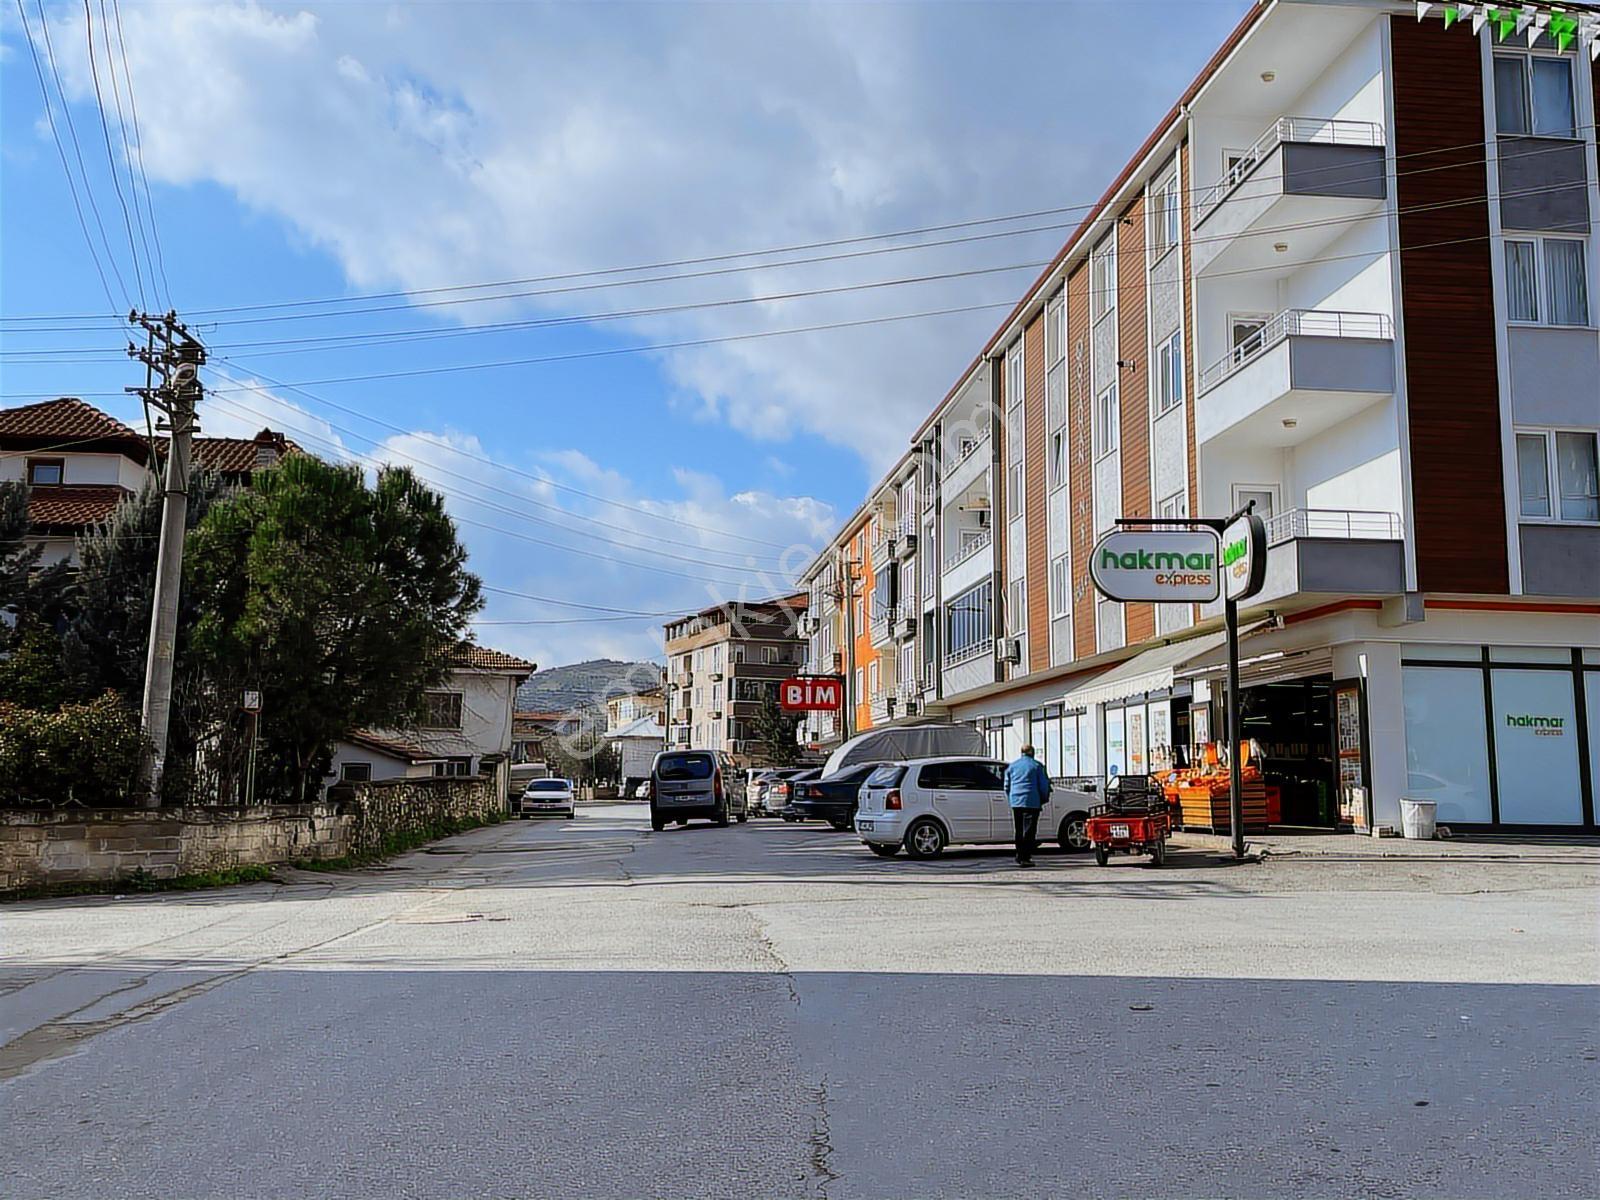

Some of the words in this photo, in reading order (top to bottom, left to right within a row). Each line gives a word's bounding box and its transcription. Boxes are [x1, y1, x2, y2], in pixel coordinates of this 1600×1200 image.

[1101, 548, 1215, 570] hakmar
[1155, 571, 1212, 587] express
[787, 680, 836, 705] BİM
[1506, 714, 1564, 727] hakmar
